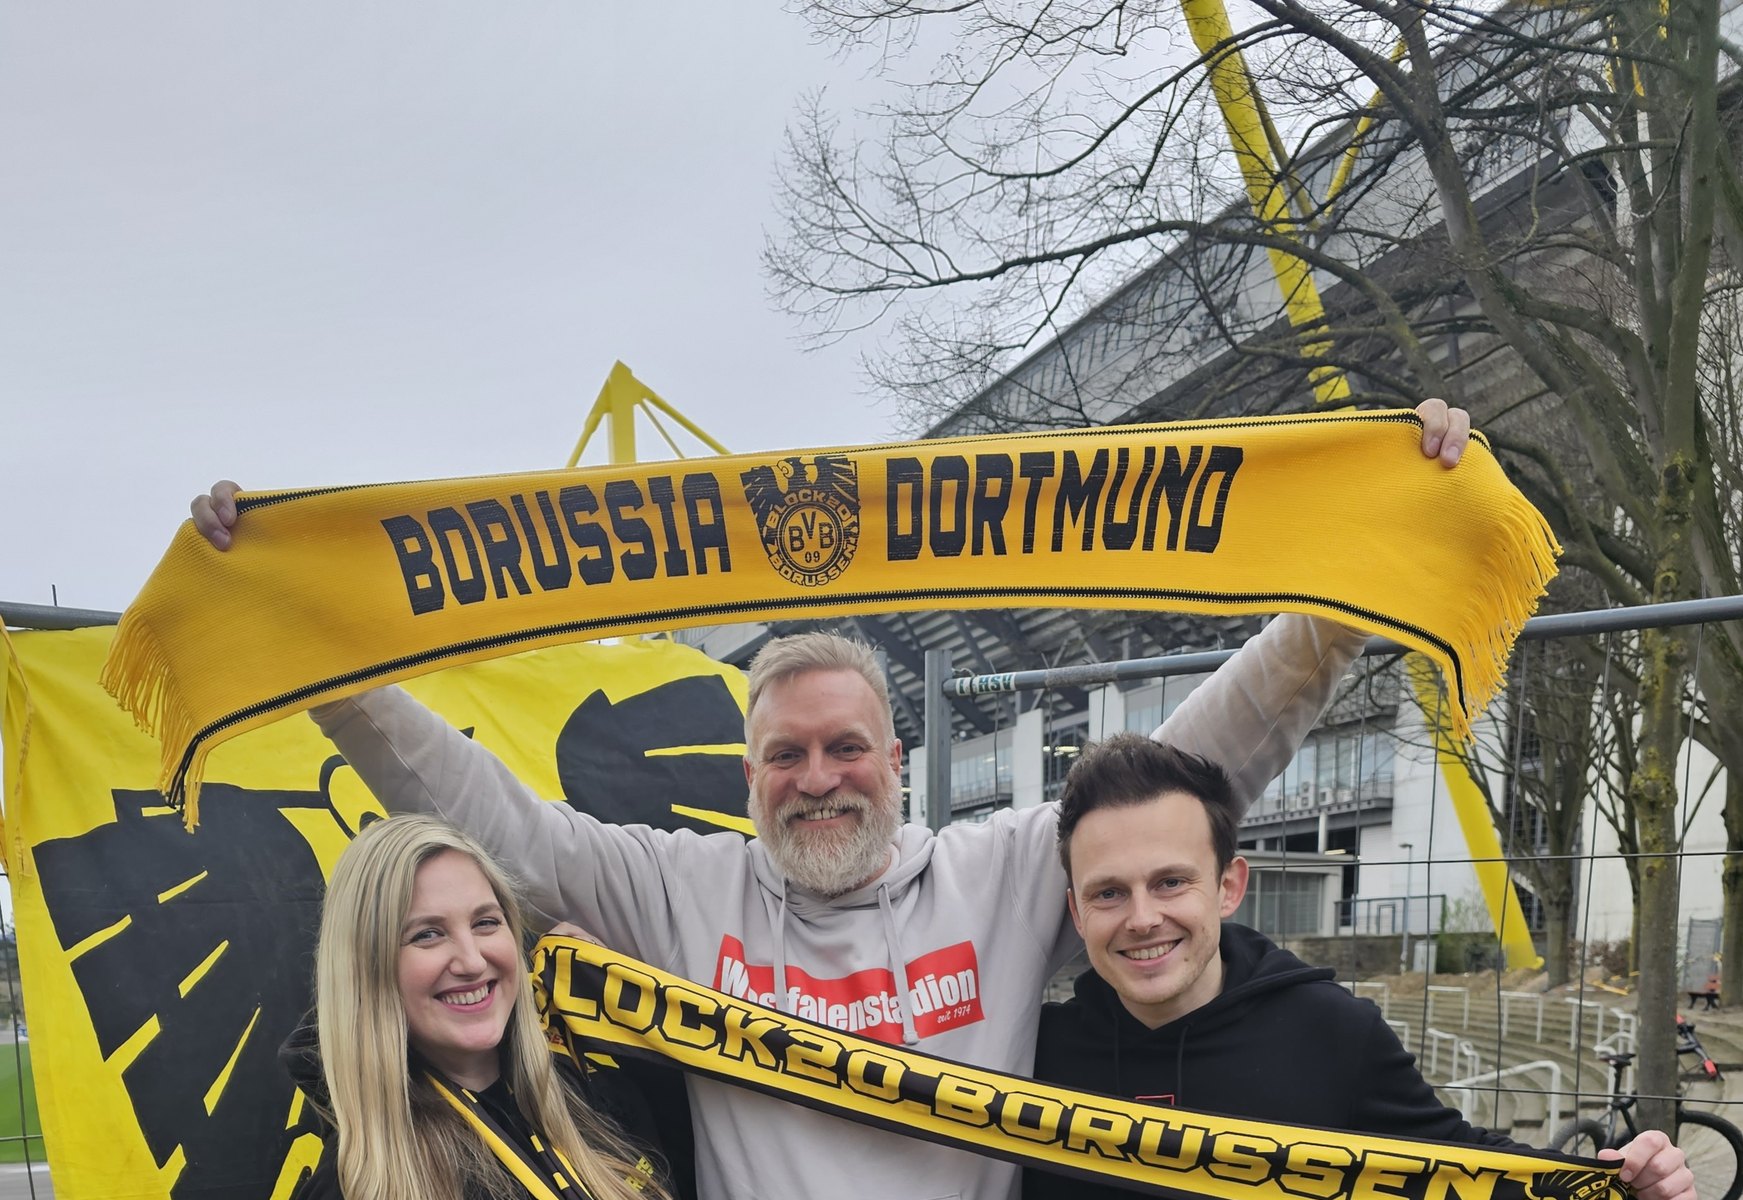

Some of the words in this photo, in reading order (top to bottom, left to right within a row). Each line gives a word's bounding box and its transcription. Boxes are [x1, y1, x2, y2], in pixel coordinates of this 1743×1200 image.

[766, 489, 851, 528] BLOCK20
[380, 472, 731, 616] BORUSSIA
[886, 445, 1244, 561] DORTMUND
[789, 511, 835, 552] BVB
[768, 544, 857, 587] BORUSSEN
[805, 551, 820, 563] 09
[720, 955, 977, 1032] Wsfalenstadion
[953, 1004, 971, 1019] 1974
